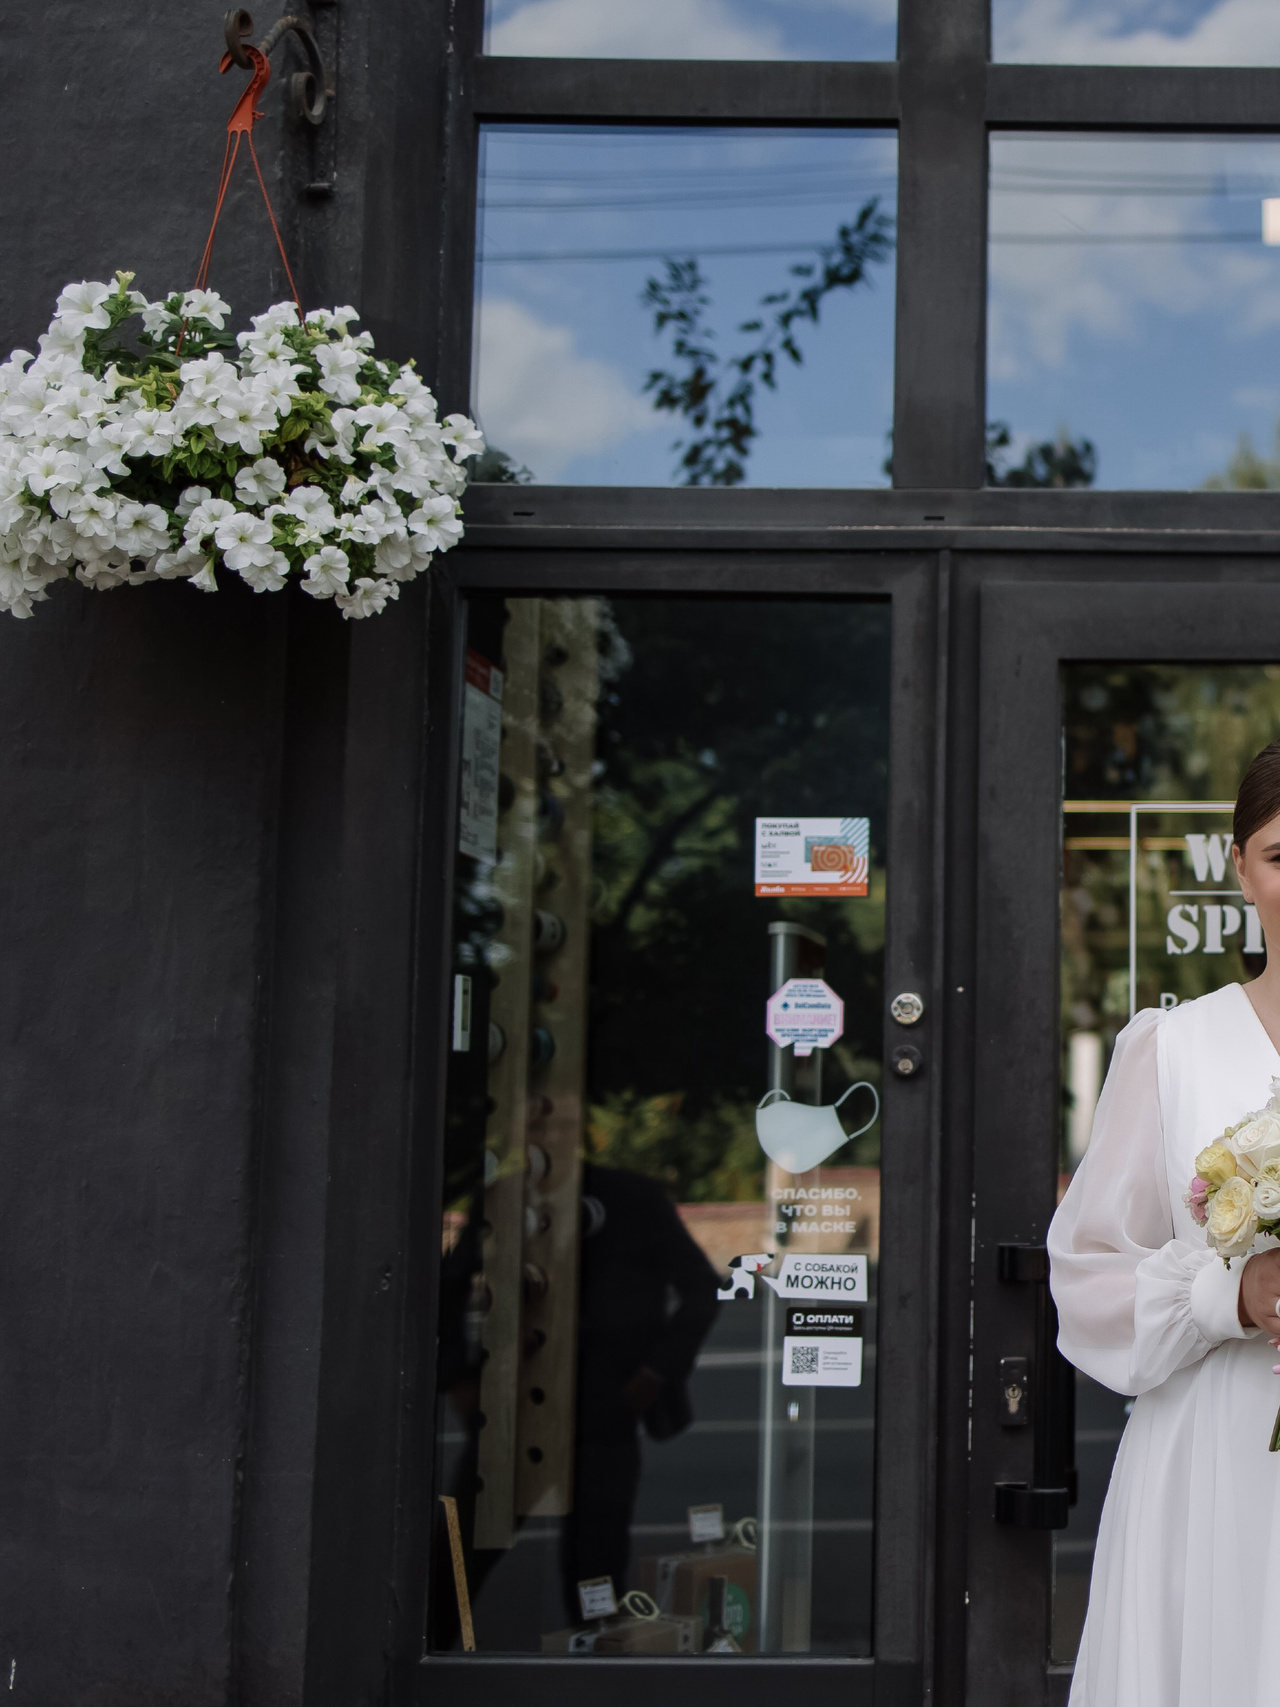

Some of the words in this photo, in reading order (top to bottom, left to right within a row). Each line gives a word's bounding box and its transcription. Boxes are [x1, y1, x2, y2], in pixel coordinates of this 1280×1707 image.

[771, 1187, 862, 1200] СПАСИБО,
[781, 1204, 817, 1217] ЧТО
[822, 1204, 850, 1217] ВЫ
[776, 1221, 788, 1233] В
[792, 1221, 856, 1233] МАСКЕ
[794, 1262, 802, 1271] С
[805, 1262, 858, 1274] СОБАКОЙ
[785, 1274, 857, 1291] МОЖНО
[806, 1314, 854, 1324] ОПЛАТИ
